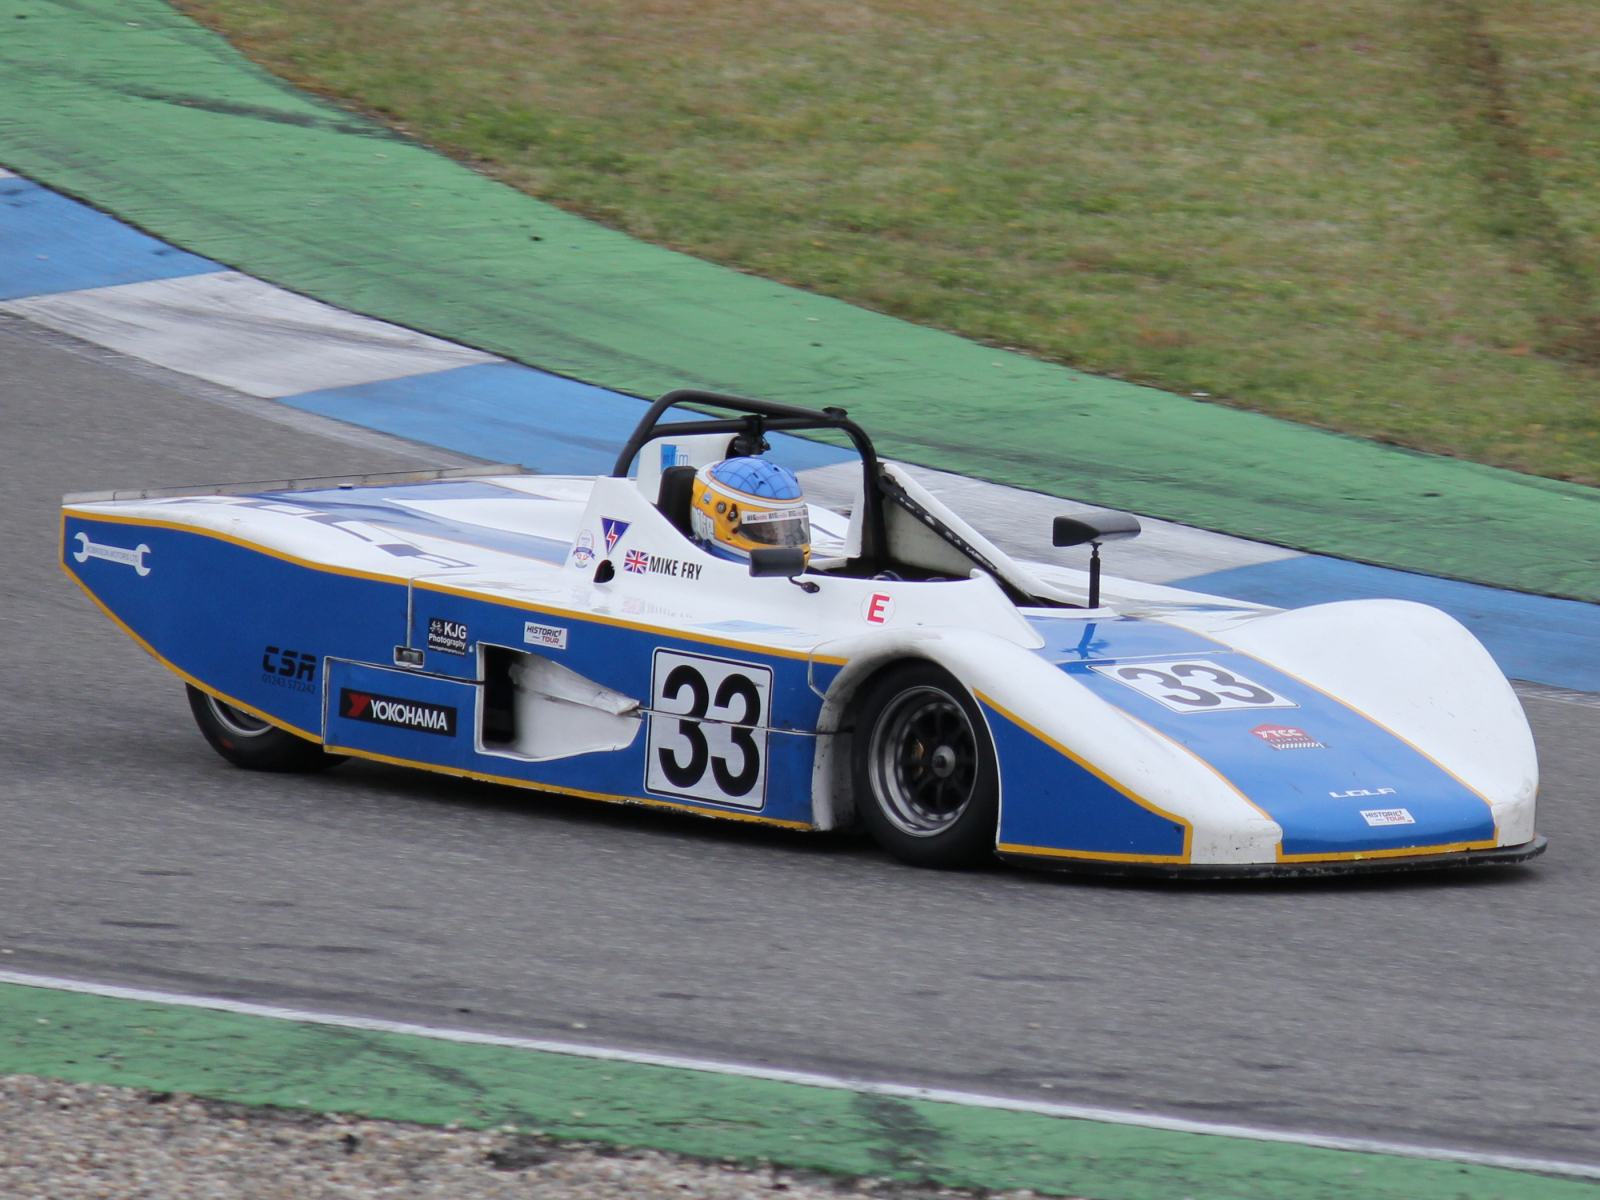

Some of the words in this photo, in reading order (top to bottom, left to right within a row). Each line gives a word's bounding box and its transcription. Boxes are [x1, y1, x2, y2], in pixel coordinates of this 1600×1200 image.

[648, 556, 679, 577] MIKE
[681, 561, 703, 581] FRY
[867, 593, 891, 624] E
[428, 633, 466, 650] Photography
[444, 621, 467, 639] KJG
[526, 625, 561, 637] HISTORIC
[541, 636, 560, 645] TOUR
[262, 645, 317, 682] CSR
[262, 673, 286, 688] 01243
[287, 679, 316, 695] 572242
[1117, 664, 1275, 707] 33
[370, 699, 448, 731] YOKOHAMA
[658, 664, 761, 797] 33
[1328, 787, 1397, 798] LOLA
